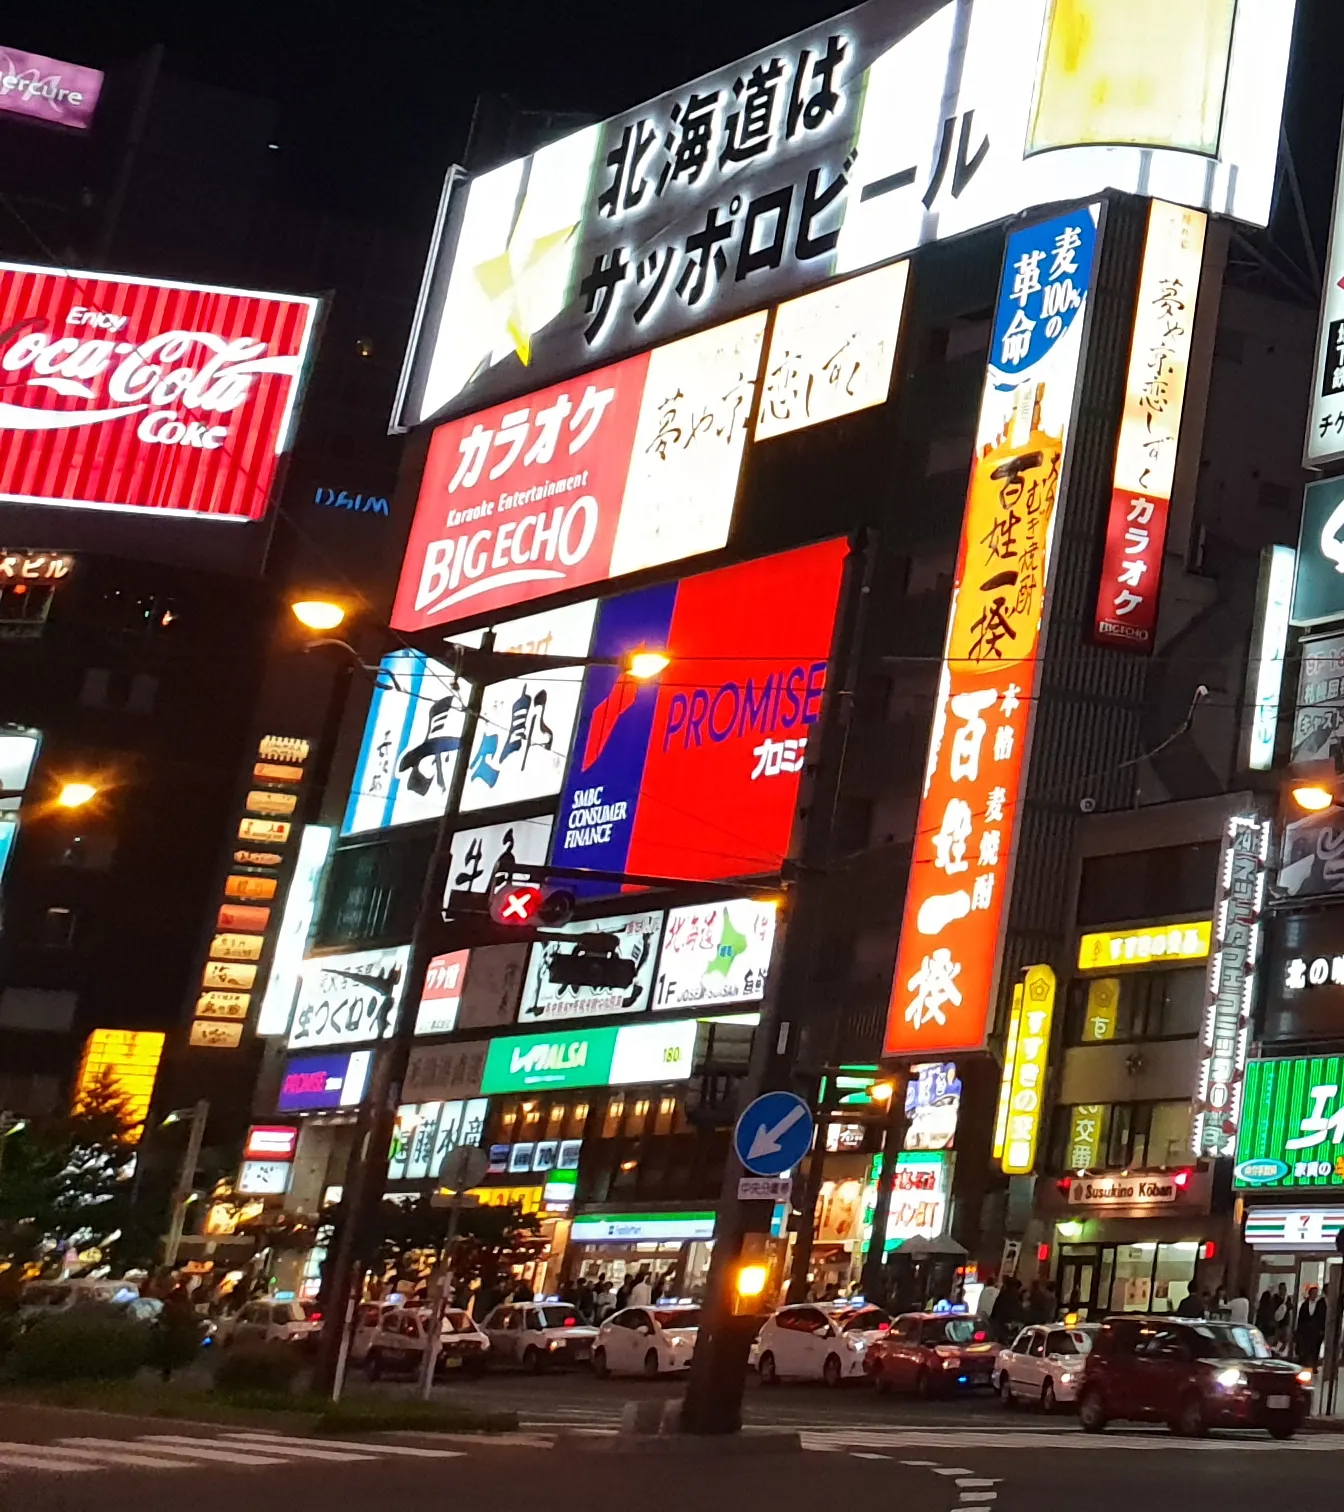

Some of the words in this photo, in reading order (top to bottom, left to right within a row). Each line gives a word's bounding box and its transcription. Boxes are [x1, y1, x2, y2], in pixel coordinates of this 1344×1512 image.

[0, 69, 83, 107] ercure
[602, 34, 850, 217] 北海道は
[582, 108, 991, 346] サッポロビール
[66, 305, 127, 332] Enjoy
[1000, 249, 1047, 366] 革命
[138, 411, 229, 449] Coke
[447, 385, 615, 494] カラオケ
[446, 499, 496, 528] Karaoke
[497, 469, 589, 513] Entertainment
[414, 529, 493, 612] BIG
[491, 495, 599, 569] ECHO
[969, 451, 1044, 664] 百姓一揆
[1111, 497, 1156, 618] カラオケ
[662, 660, 828, 754] PROMISE
[568, 800, 628, 829] CONSUMER
[571, 785, 604, 808] SMBC
[564, 823, 612, 849] FINANCE
[904, 687, 1000, 1031] 百姓一揆
[657, 974, 677, 1006] 1F
[1085, 1180, 1134, 1199] Susukino
